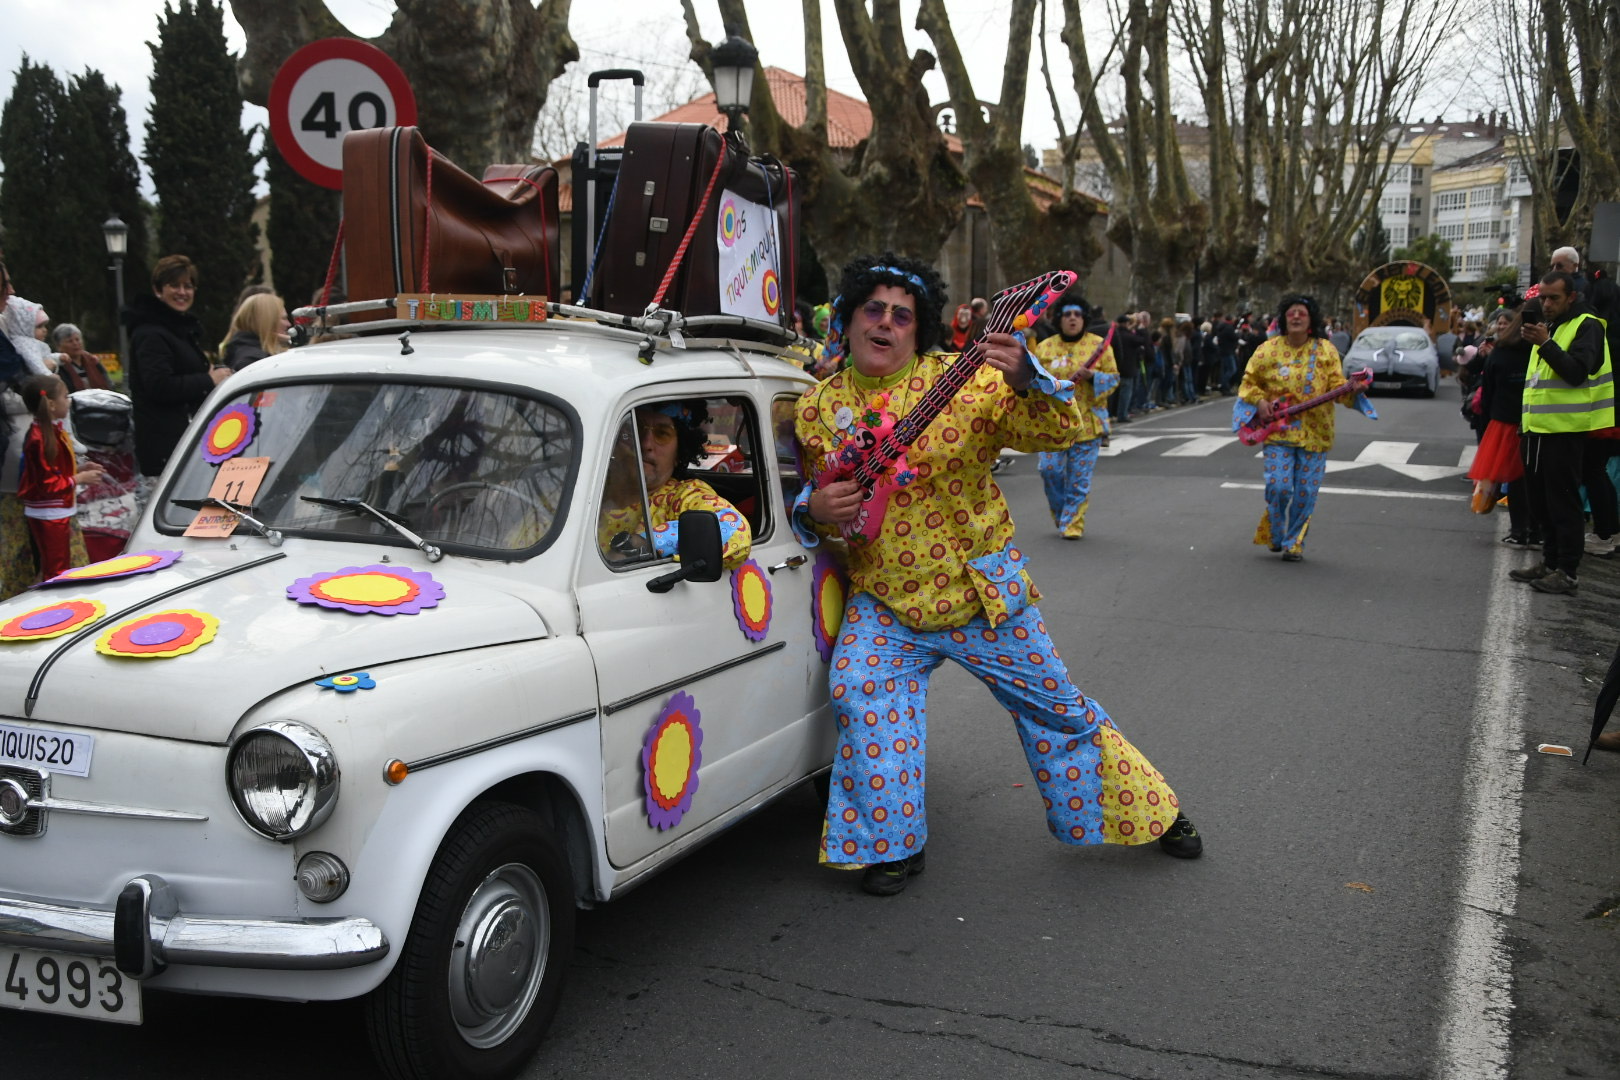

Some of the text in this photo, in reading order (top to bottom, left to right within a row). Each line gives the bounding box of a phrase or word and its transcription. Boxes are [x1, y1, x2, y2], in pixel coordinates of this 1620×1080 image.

[301, 91, 387, 138] 40
[222, 480, 245, 503] 11
[5, 953, 124, 1012] 4993
